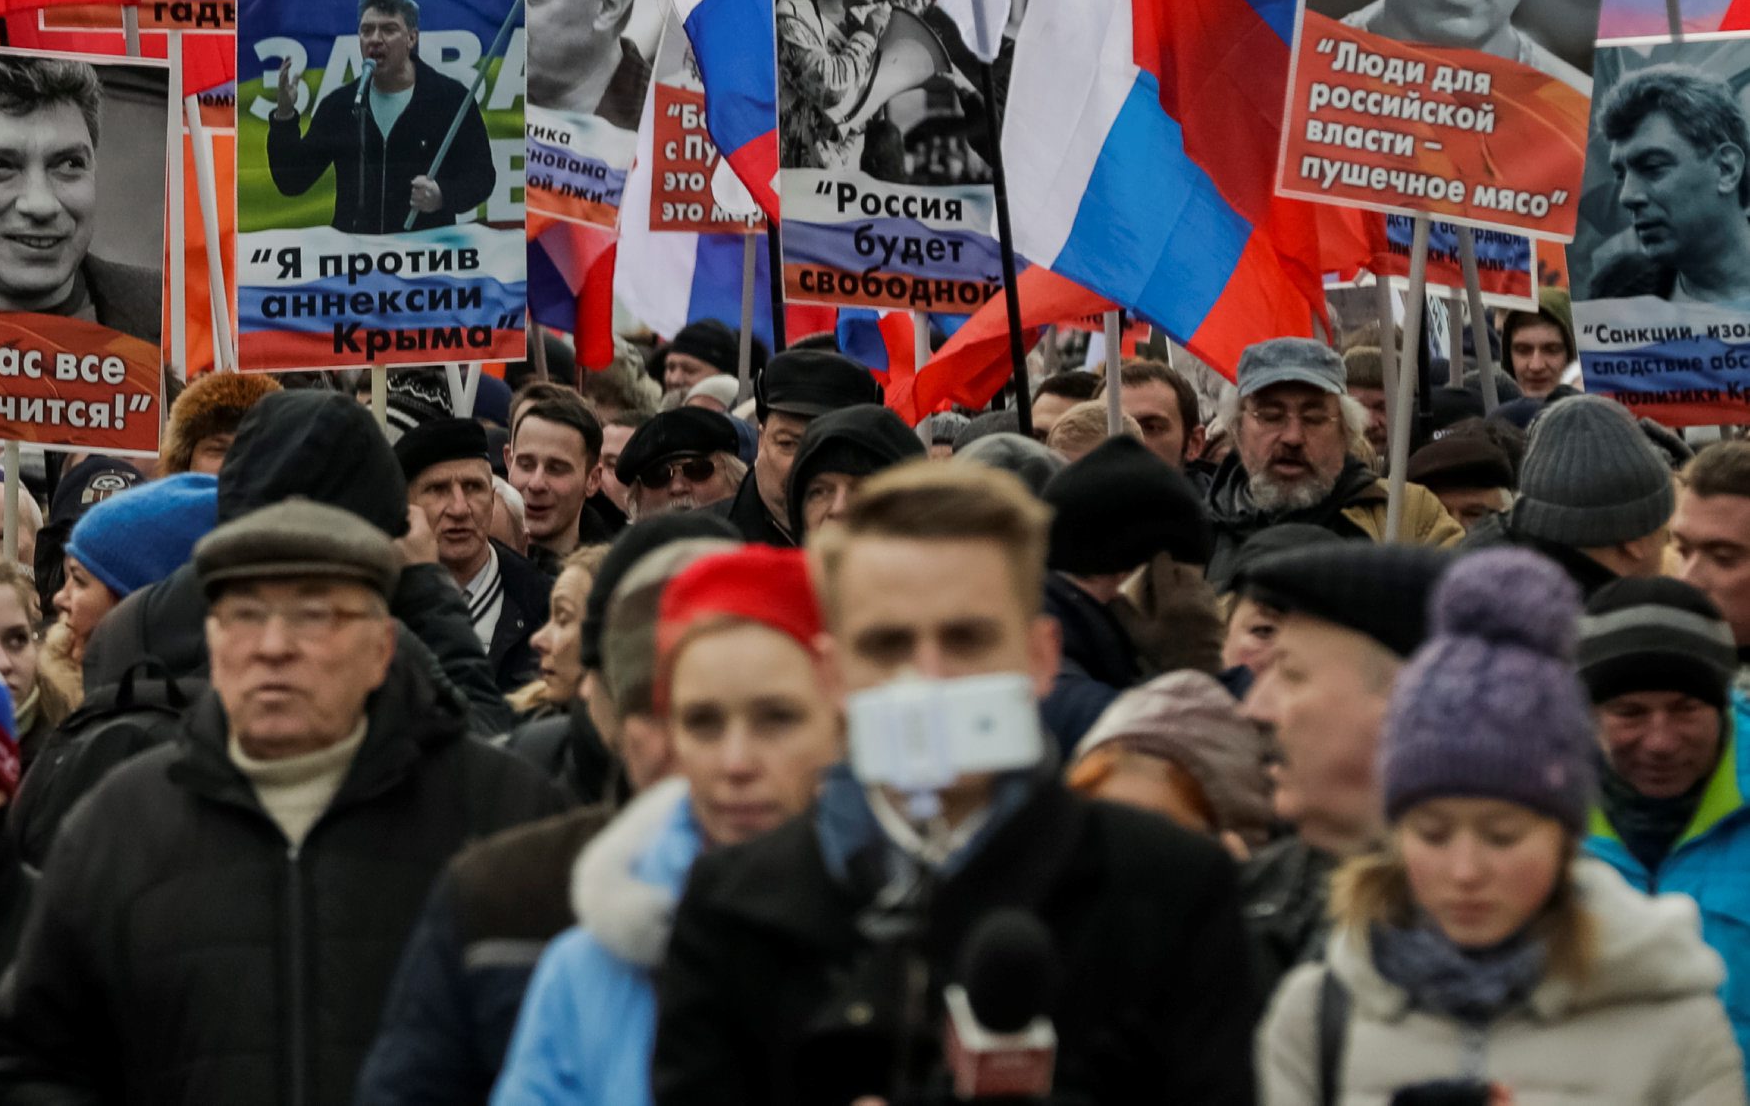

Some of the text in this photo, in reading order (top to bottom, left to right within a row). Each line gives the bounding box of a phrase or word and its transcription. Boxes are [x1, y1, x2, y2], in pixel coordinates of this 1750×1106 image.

[1316, 38, 1493, 95] “Люди для
[1308, 81, 1496, 134] российской
[526, 122, 571, 146] тика
[685, 135, 719, 168] Пу
[1306, 119, 1415, 157] власти
[664, 172, 705, 192] это
[815, 180, 963, 221] “Россия
[1301, 156, 1569, 218] пушечное мясо”
[662, 202, 704, 224] это
[853, 223, 964, 266] будет
[250, 247, 480, 286] “Я против
[260, 286, 482, 319] аннексии
[333, 315, 519, 361] Крыма”
[55, 352, 126, 385] все
[1593, 349, 1750, 377] следствие абс
